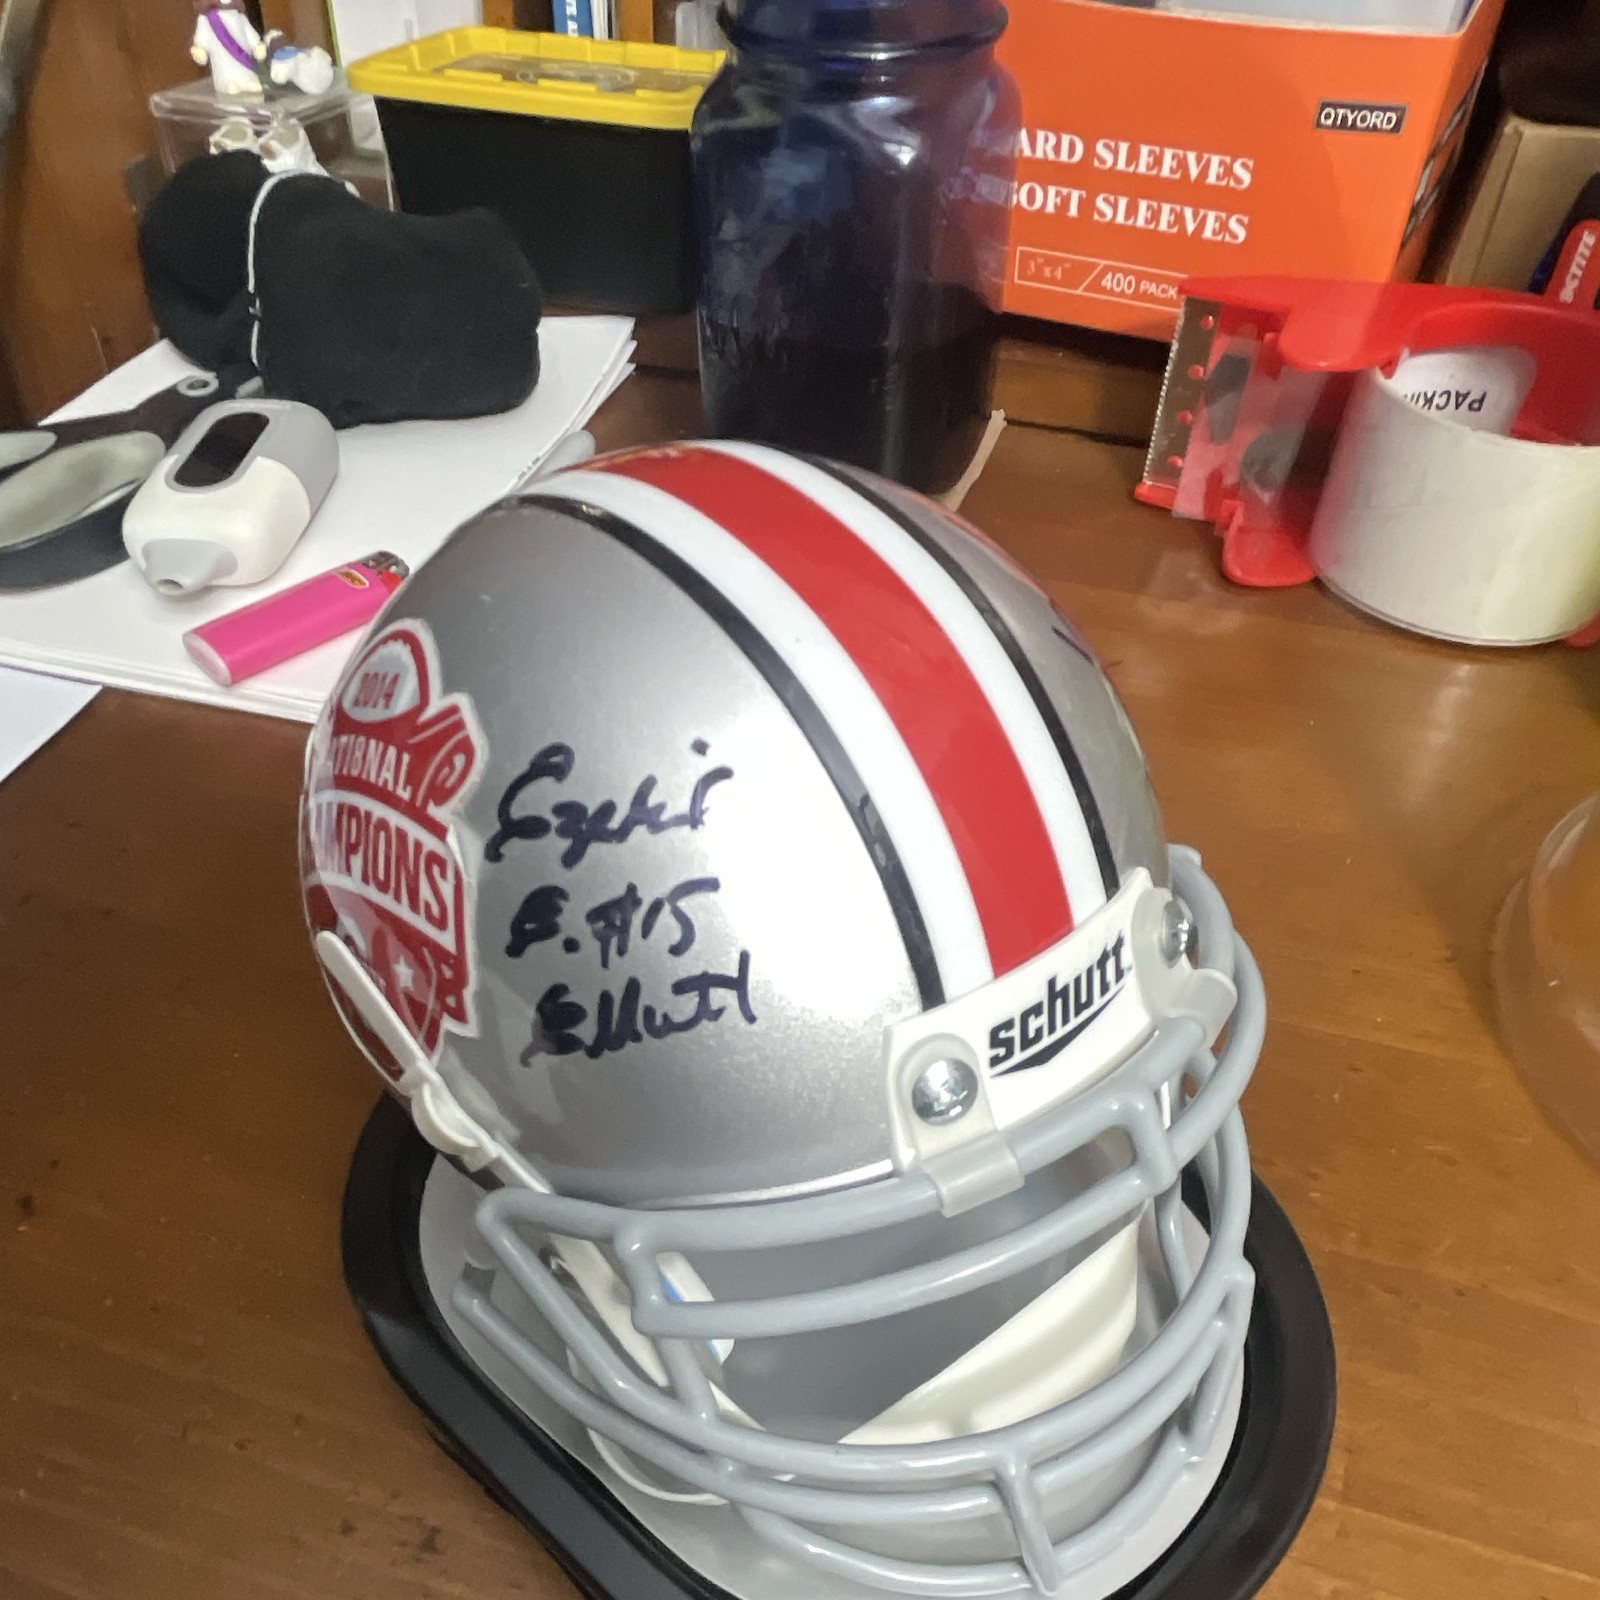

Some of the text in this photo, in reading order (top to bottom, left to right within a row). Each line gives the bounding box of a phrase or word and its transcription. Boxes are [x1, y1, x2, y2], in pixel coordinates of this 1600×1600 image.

[1320, 107, 1397, 131] QTYORD
[1015, 127, 1254, 190] ARD SLEEVES
[1093, 193, 1249, 244] SLEEVES
[1101, 271, 1136, 294] 400
[989, 929, 1126, 1069] schutt
